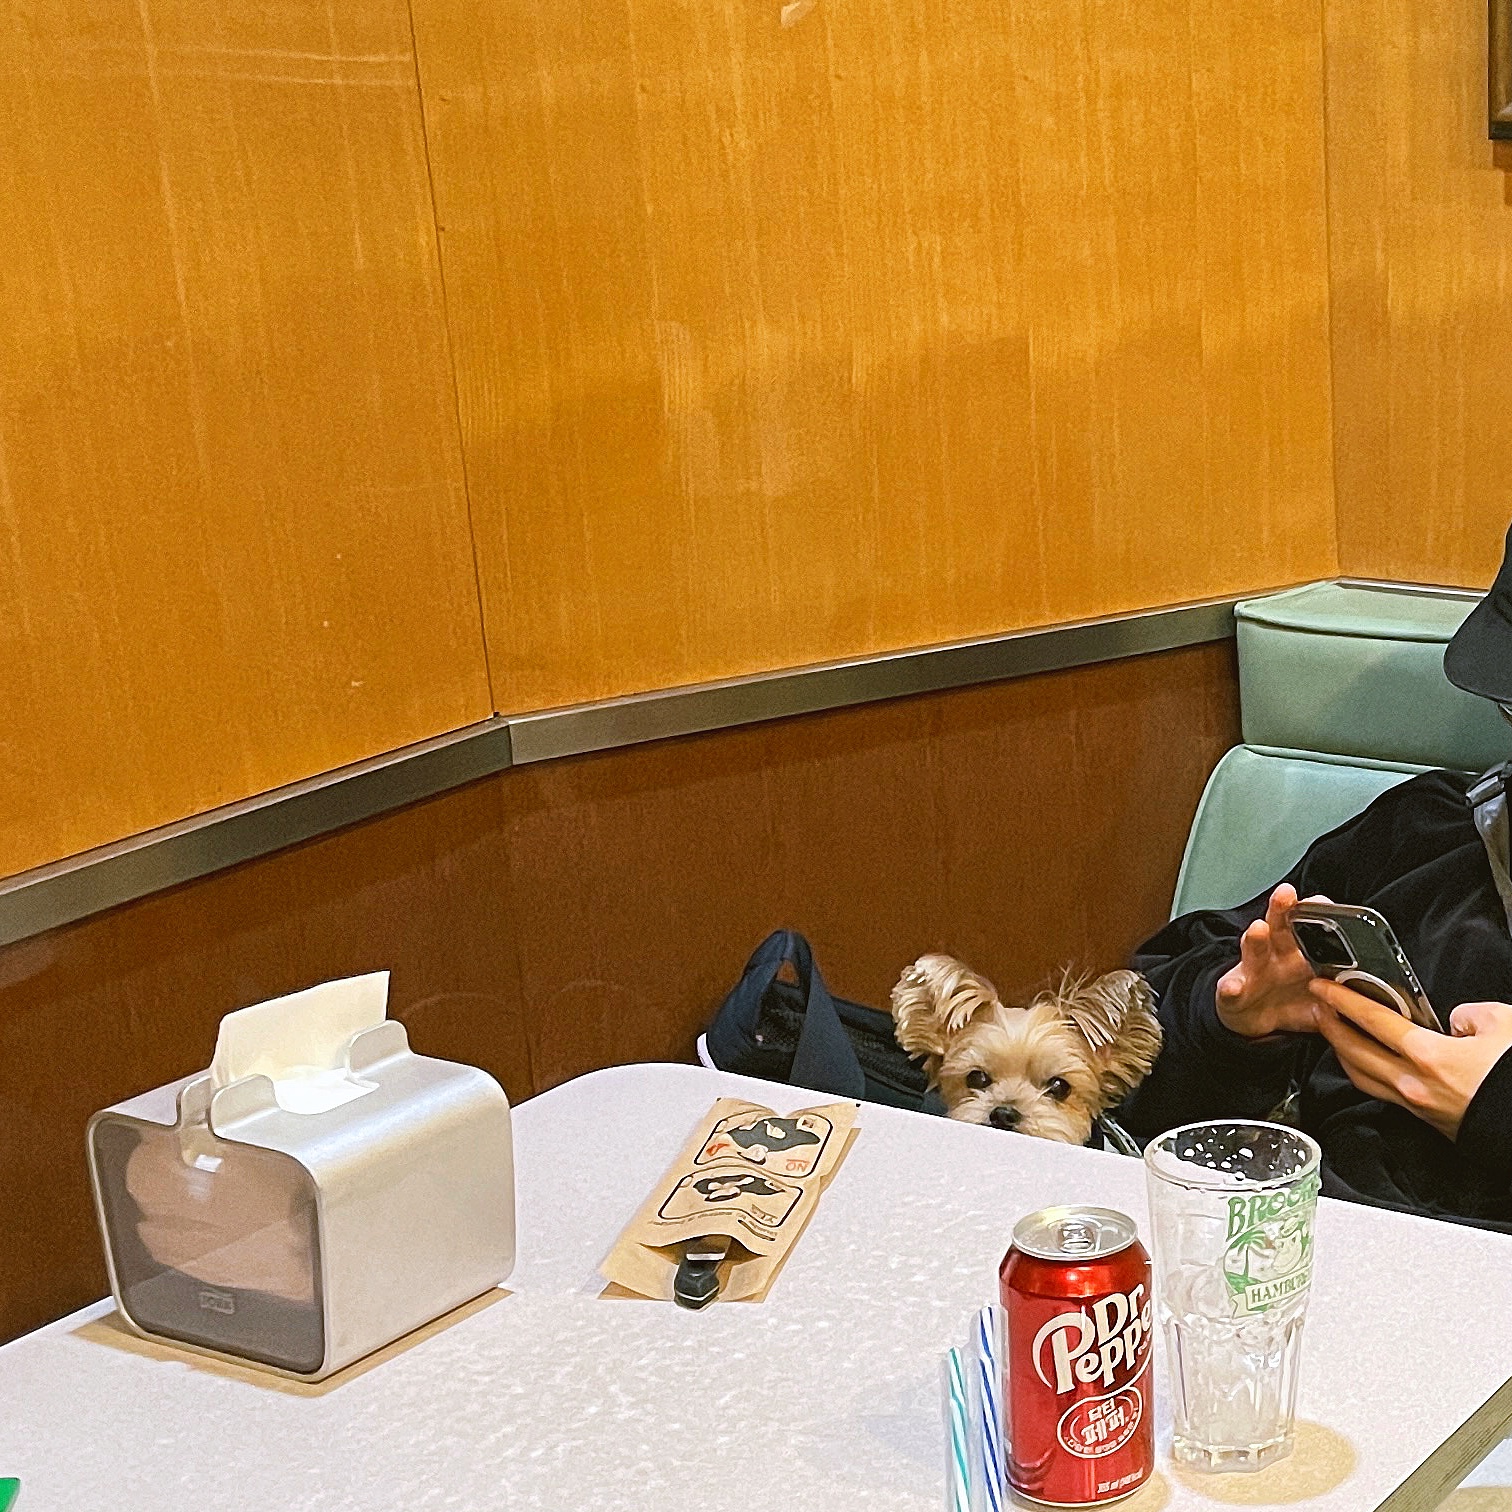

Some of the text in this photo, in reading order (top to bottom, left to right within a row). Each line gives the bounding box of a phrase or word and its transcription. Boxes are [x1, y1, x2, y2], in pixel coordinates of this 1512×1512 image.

[785, 1162, 810, 1173] NO
[1092, 1284, 1145, 1346] Dr
[1032, 1300, 1151, 1395] Peppe
[1080, 1406, 1125, 1445] 페퍼
